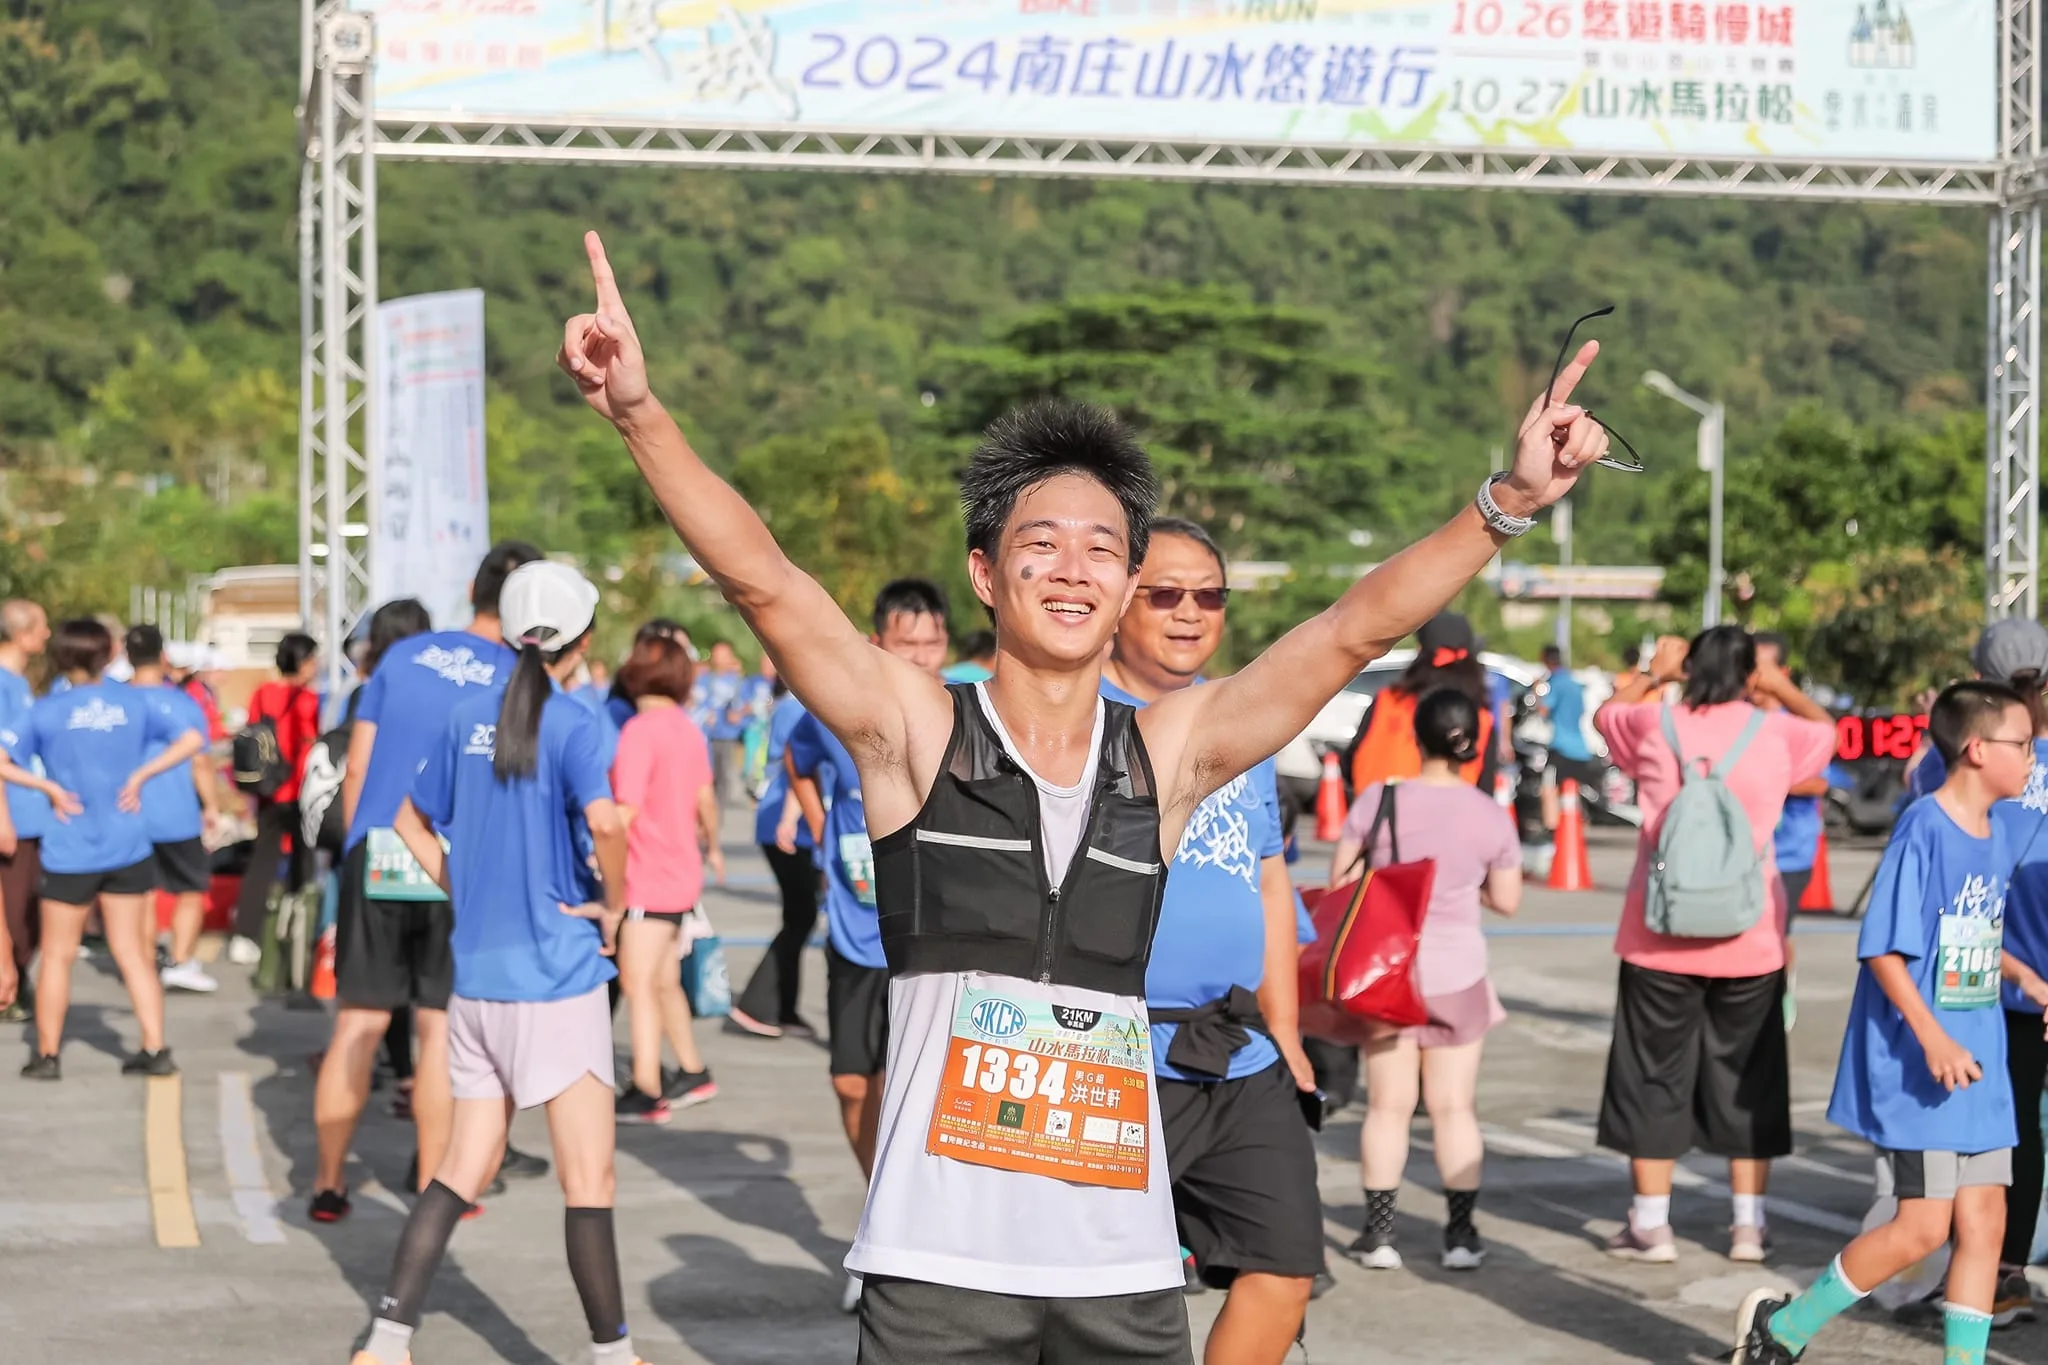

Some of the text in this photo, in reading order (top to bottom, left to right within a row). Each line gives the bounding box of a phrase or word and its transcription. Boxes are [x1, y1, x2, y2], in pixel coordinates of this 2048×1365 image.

[1449, 0, 1573, 39] 10.26
[802, 32, 1438, 108] 2024南庄山水悠遊行
[1449, 79, 1568, 114] 10.27
[1581, 78, 1795, 124] 山水馬拉松
[974, 1001, 1024, 1035] JKCR
[1061, 1008, 1094, 1024] 21KM
[1027, 1038, 1111, 1065] 山水馬拉松
[961, 1044, 1069, 1106] 1334
[1068, 1082, 1121, 1109] 洪世軒
